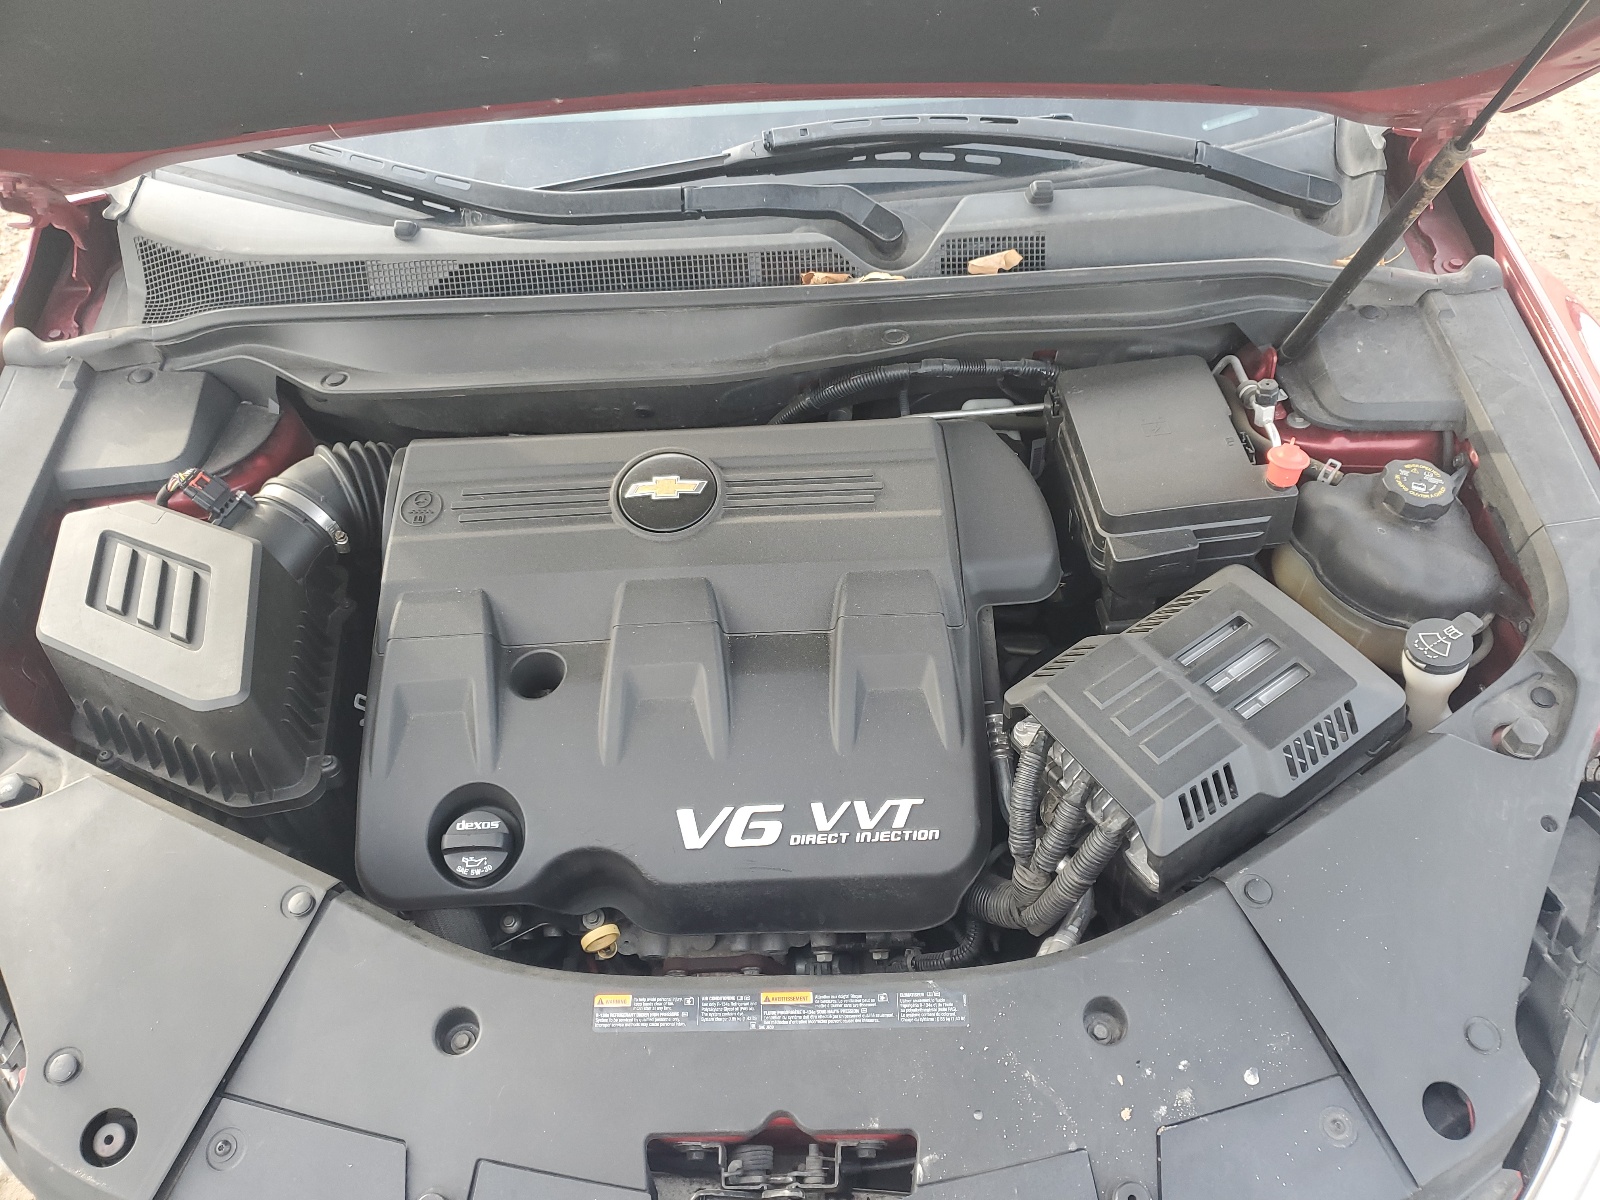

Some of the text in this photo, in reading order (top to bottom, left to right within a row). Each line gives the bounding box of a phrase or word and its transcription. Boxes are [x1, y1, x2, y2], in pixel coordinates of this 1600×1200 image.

[810, 798, 925, 831] VVT
[456, 820, 502, 830] dexos
[676, 804, 785, 850] V6
[790, 830, 940, 846] DIRECT INJECTION
[456, 864, 493, 876] SAE 5W-30
